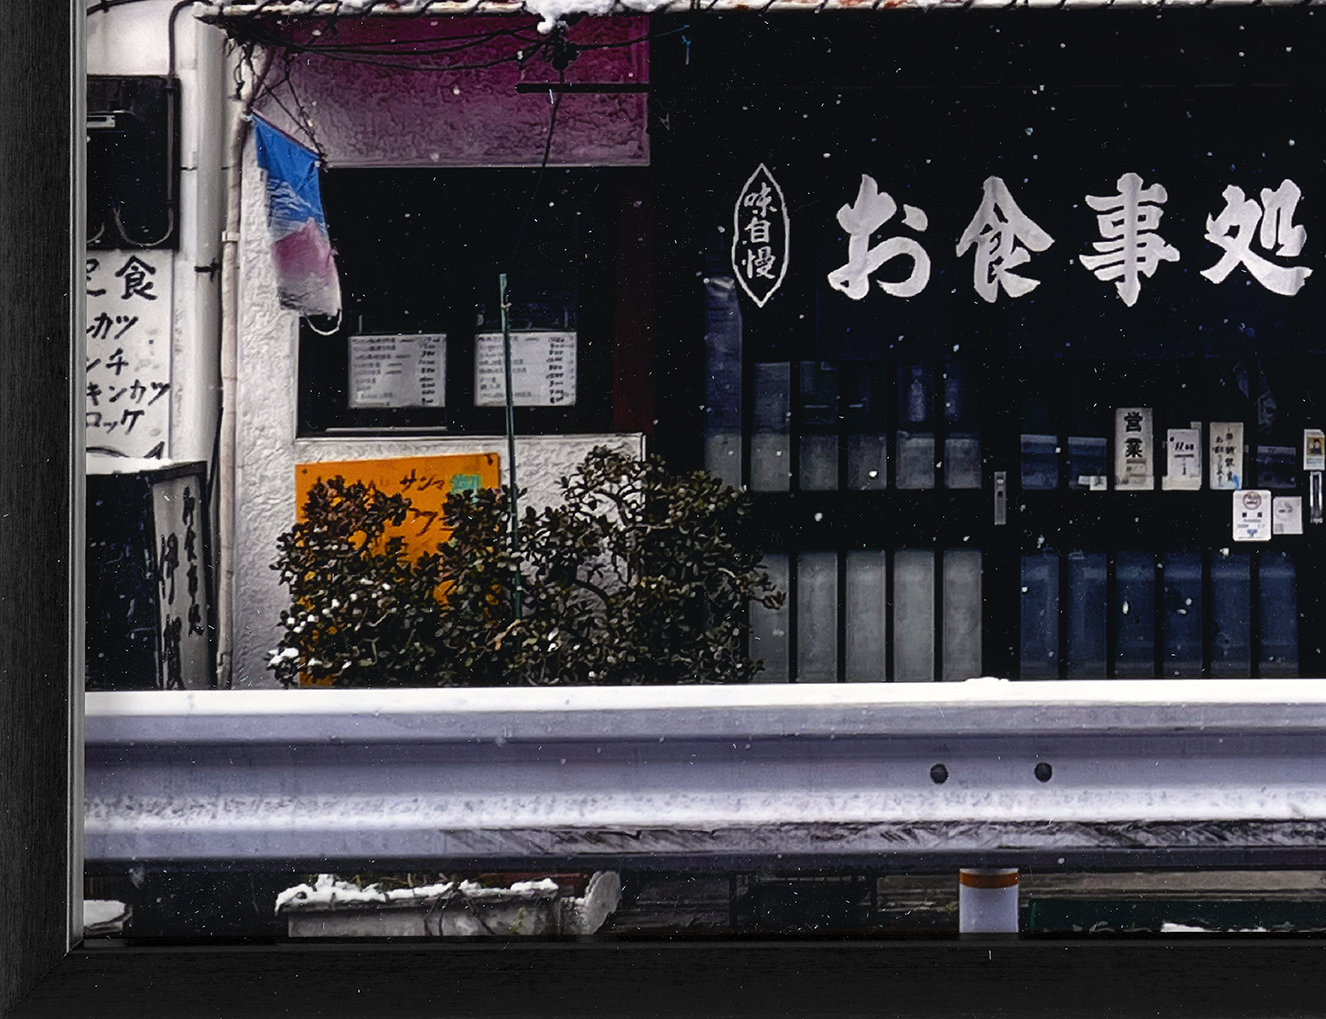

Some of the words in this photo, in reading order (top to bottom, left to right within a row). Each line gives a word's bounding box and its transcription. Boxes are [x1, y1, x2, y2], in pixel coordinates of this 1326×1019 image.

[743, 181, 778, 280] 味自慢
[826, 172, 1314, 308] お食事処
